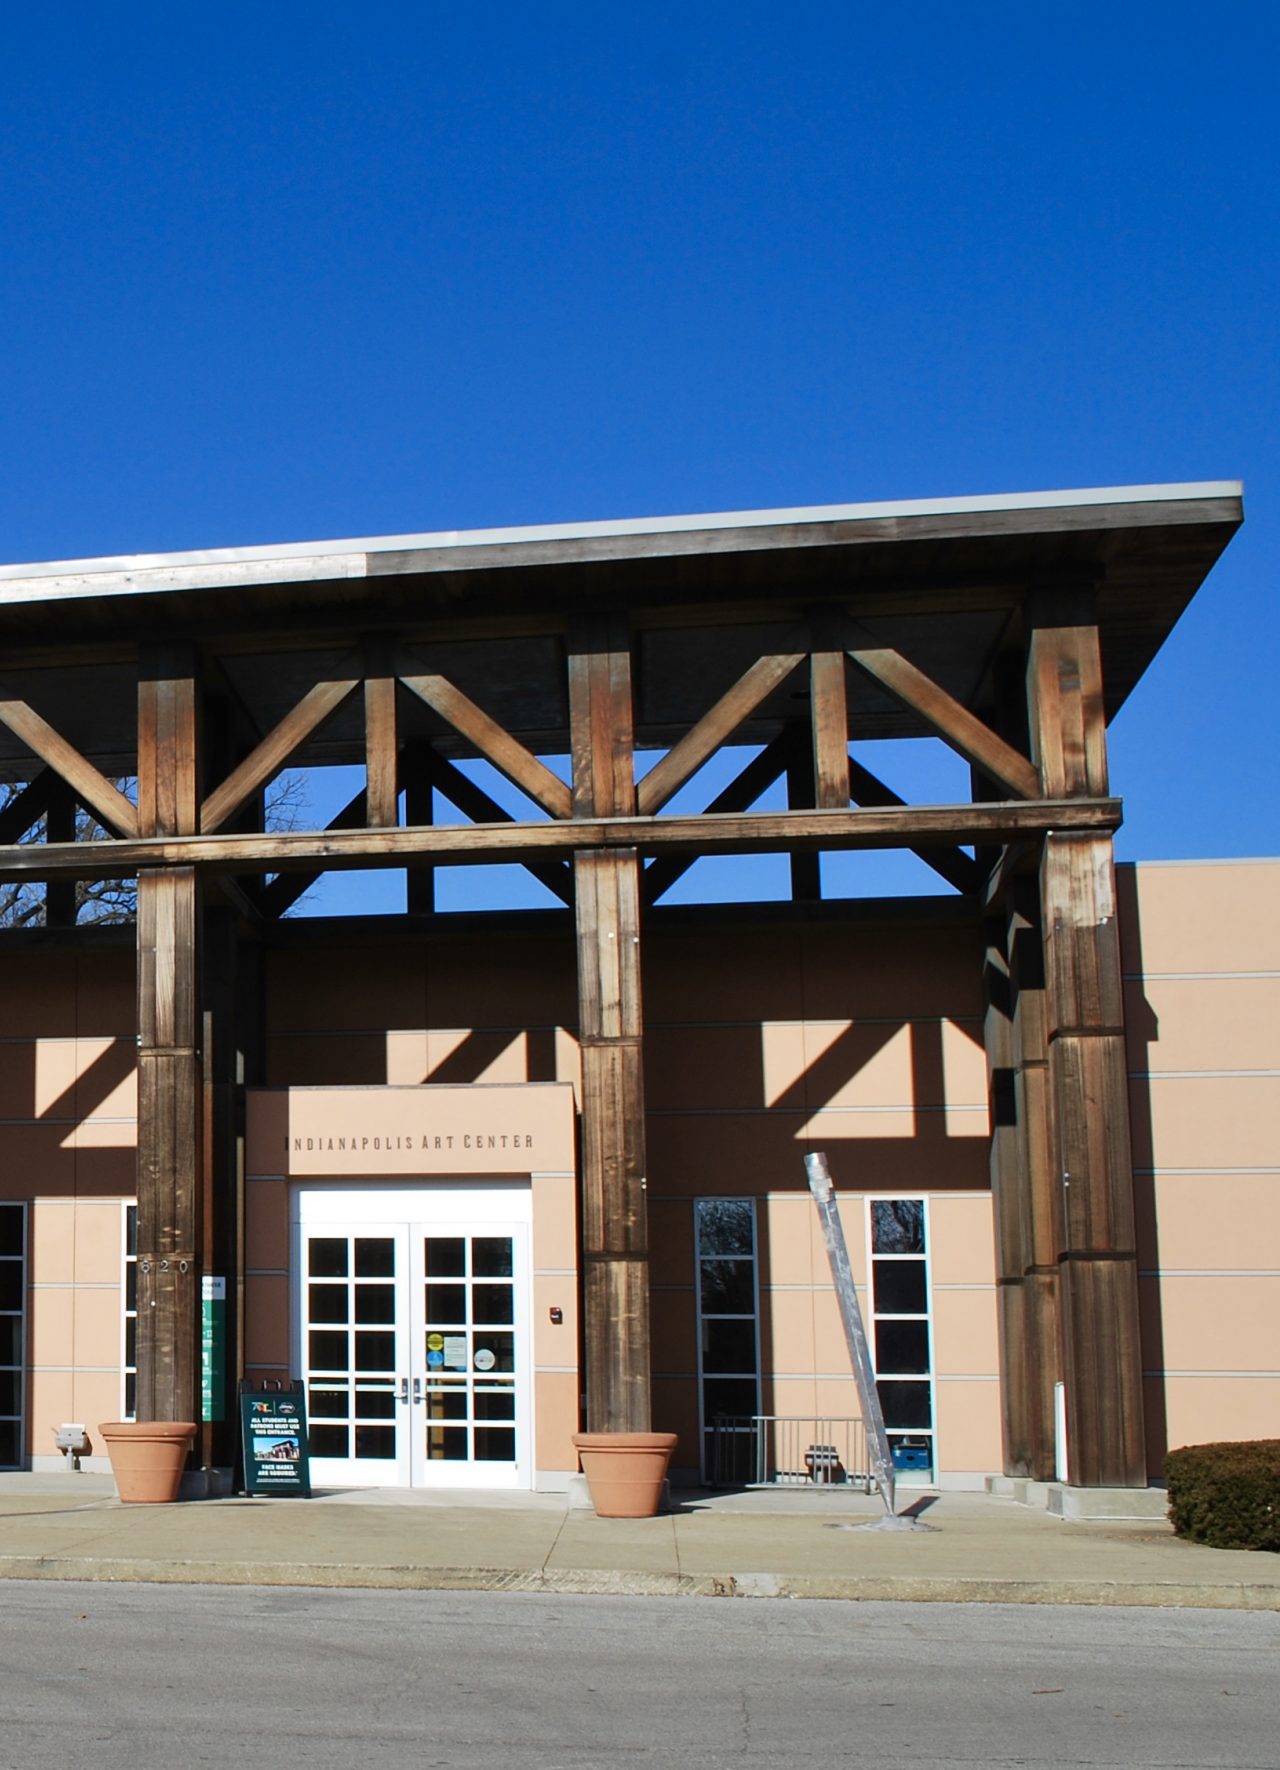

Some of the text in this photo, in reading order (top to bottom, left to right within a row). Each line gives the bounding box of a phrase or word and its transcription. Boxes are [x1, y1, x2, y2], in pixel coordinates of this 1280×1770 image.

[284, 1134, 533, 1151] INDIANAPOLIS ART CENTER
